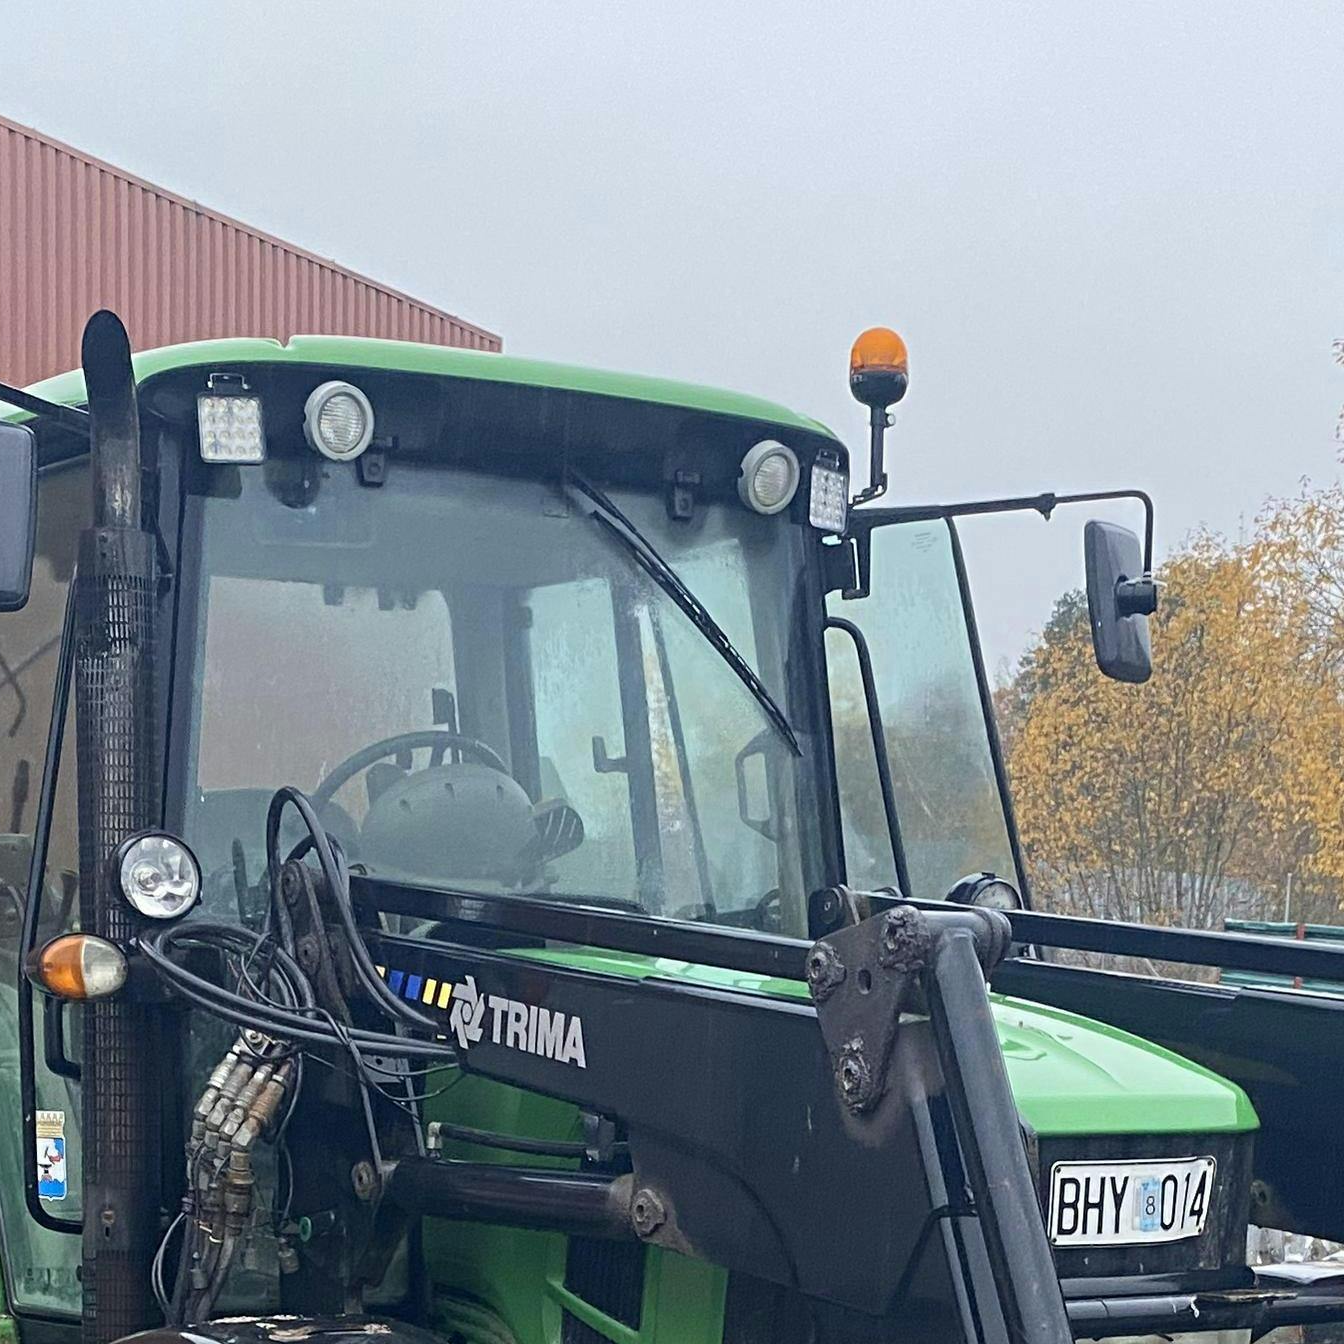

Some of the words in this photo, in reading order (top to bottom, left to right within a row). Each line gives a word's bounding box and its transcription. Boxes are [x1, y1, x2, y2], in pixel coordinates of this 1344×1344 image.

[487, 994, 587, 1069] TRIMA
[1057, 1175, 1129, 1236] BHY
[1160, 1170, 1207, 1231] 014
[1145, 1195, 1156, 1216] 8
